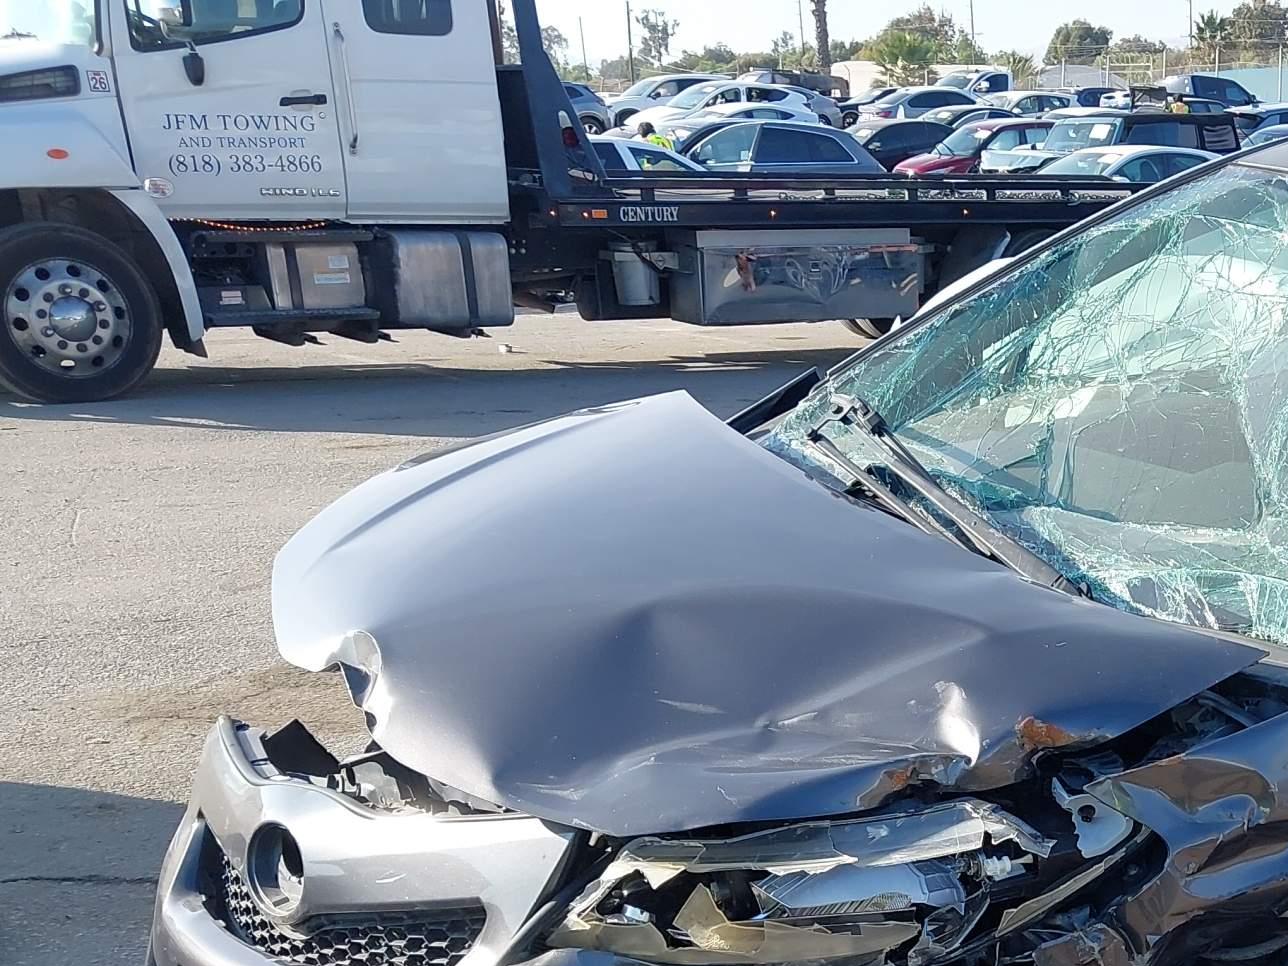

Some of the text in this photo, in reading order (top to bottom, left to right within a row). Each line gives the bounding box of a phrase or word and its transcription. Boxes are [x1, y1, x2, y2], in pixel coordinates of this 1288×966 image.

[90, 76, 107, 90] 26
[162, 113, 316, 132] JFM TOWING
[178, 136, 307, 149] AND TRANSPORT
[168, 153, 323, 177] (818) 383-4866
[259, 187, 308, 197] HINO
[619, 206, 680, 222] CENTURY
